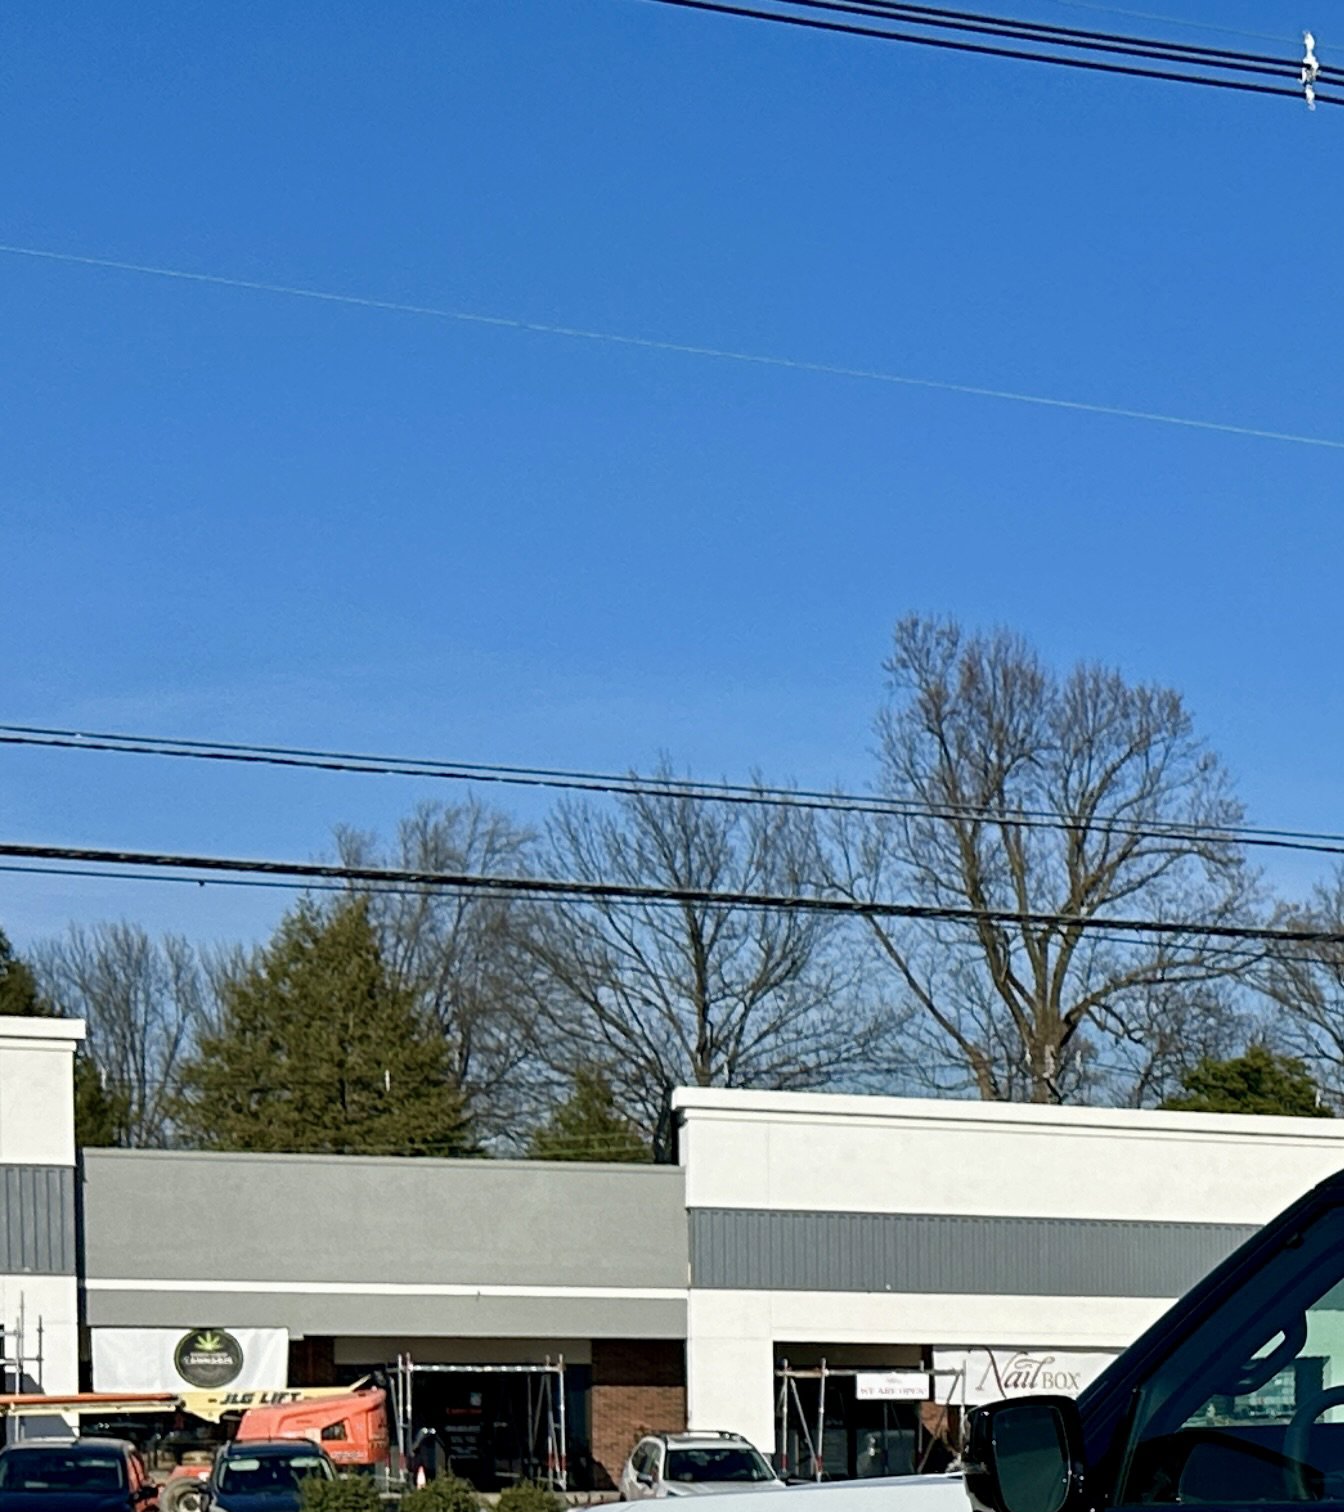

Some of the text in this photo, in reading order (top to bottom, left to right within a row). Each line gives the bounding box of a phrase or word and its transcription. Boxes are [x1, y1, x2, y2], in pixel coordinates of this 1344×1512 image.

[975, 1345, 1081, 1400] Nail BOX
[219, 1391, 301, 1405] JLG LIFT
